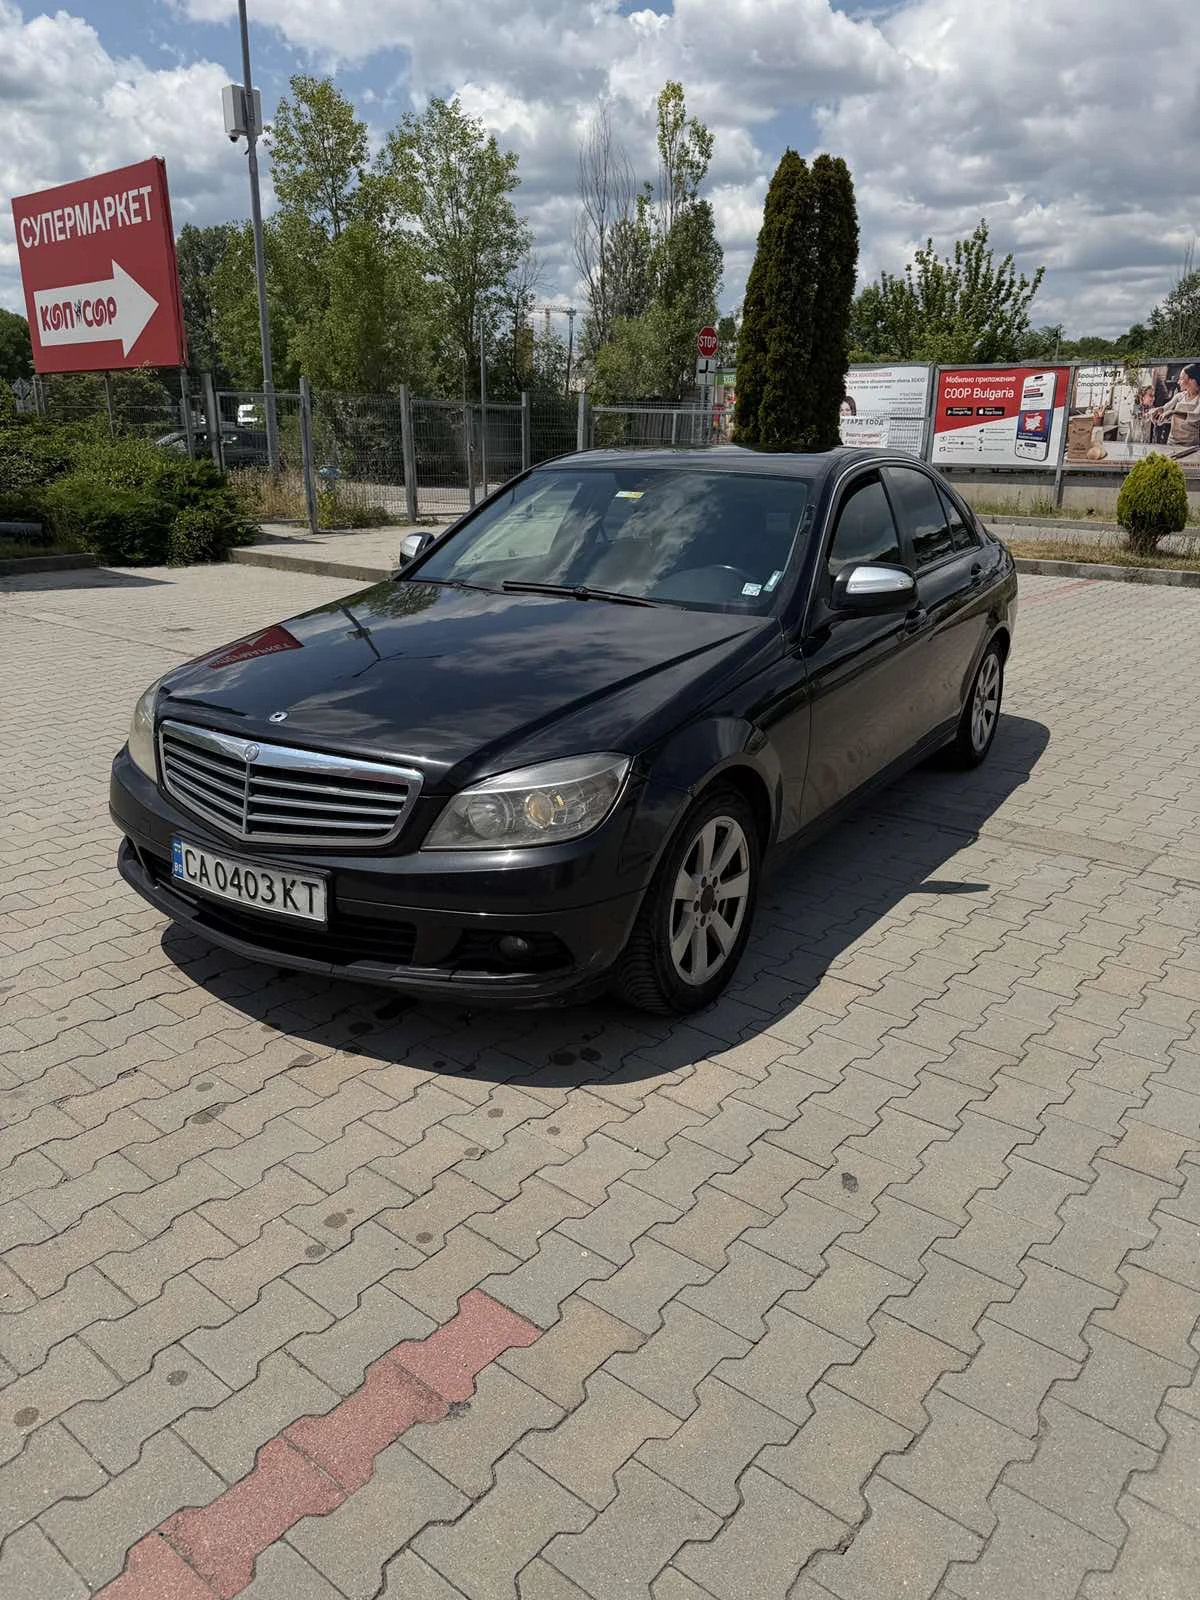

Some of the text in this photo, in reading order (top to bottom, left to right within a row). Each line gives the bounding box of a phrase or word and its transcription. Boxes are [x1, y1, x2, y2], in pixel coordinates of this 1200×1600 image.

[20, 185, 152, 248] СУПЕРМАРКЕТ
[699, 335, 717, 348] STOP
[945, 375, 1016, 384] Мобилно приложение
[944, 387, 1015, 401] COOP Bulgaria
[174, 862, 183, 873] BG
[184, 848, 319, 915] CA 0403 KT
